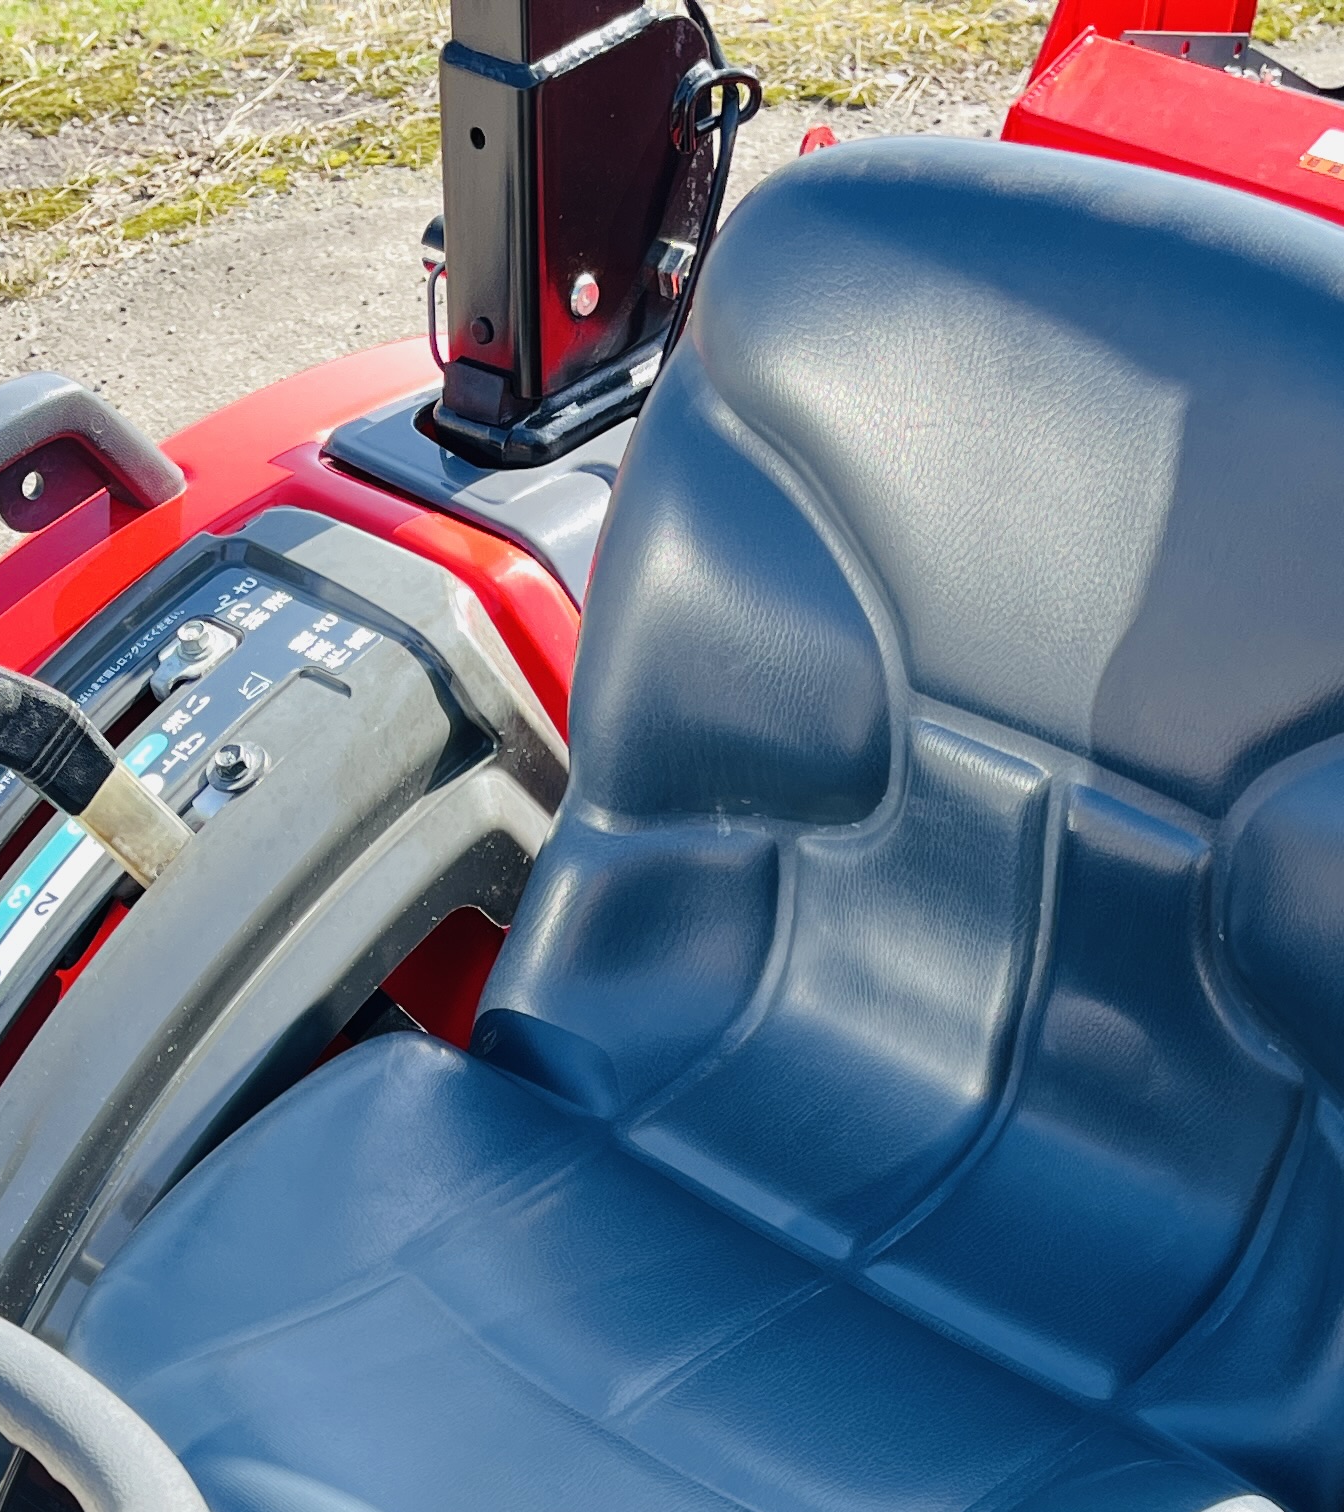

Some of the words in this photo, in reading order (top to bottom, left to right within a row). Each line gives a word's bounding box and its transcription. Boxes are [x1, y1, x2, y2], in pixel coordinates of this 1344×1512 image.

[212, 592, 271, 632] 耕うん
[231, 575, 293, 612] 深さ
[286, 628, 352, 672] 作業機
[310, 612, 376, 651] 高さ
[162, 734, 205, 773] 上げ
[5, 881, 32, 910] 3
[34, 890, 59, 918] 2
